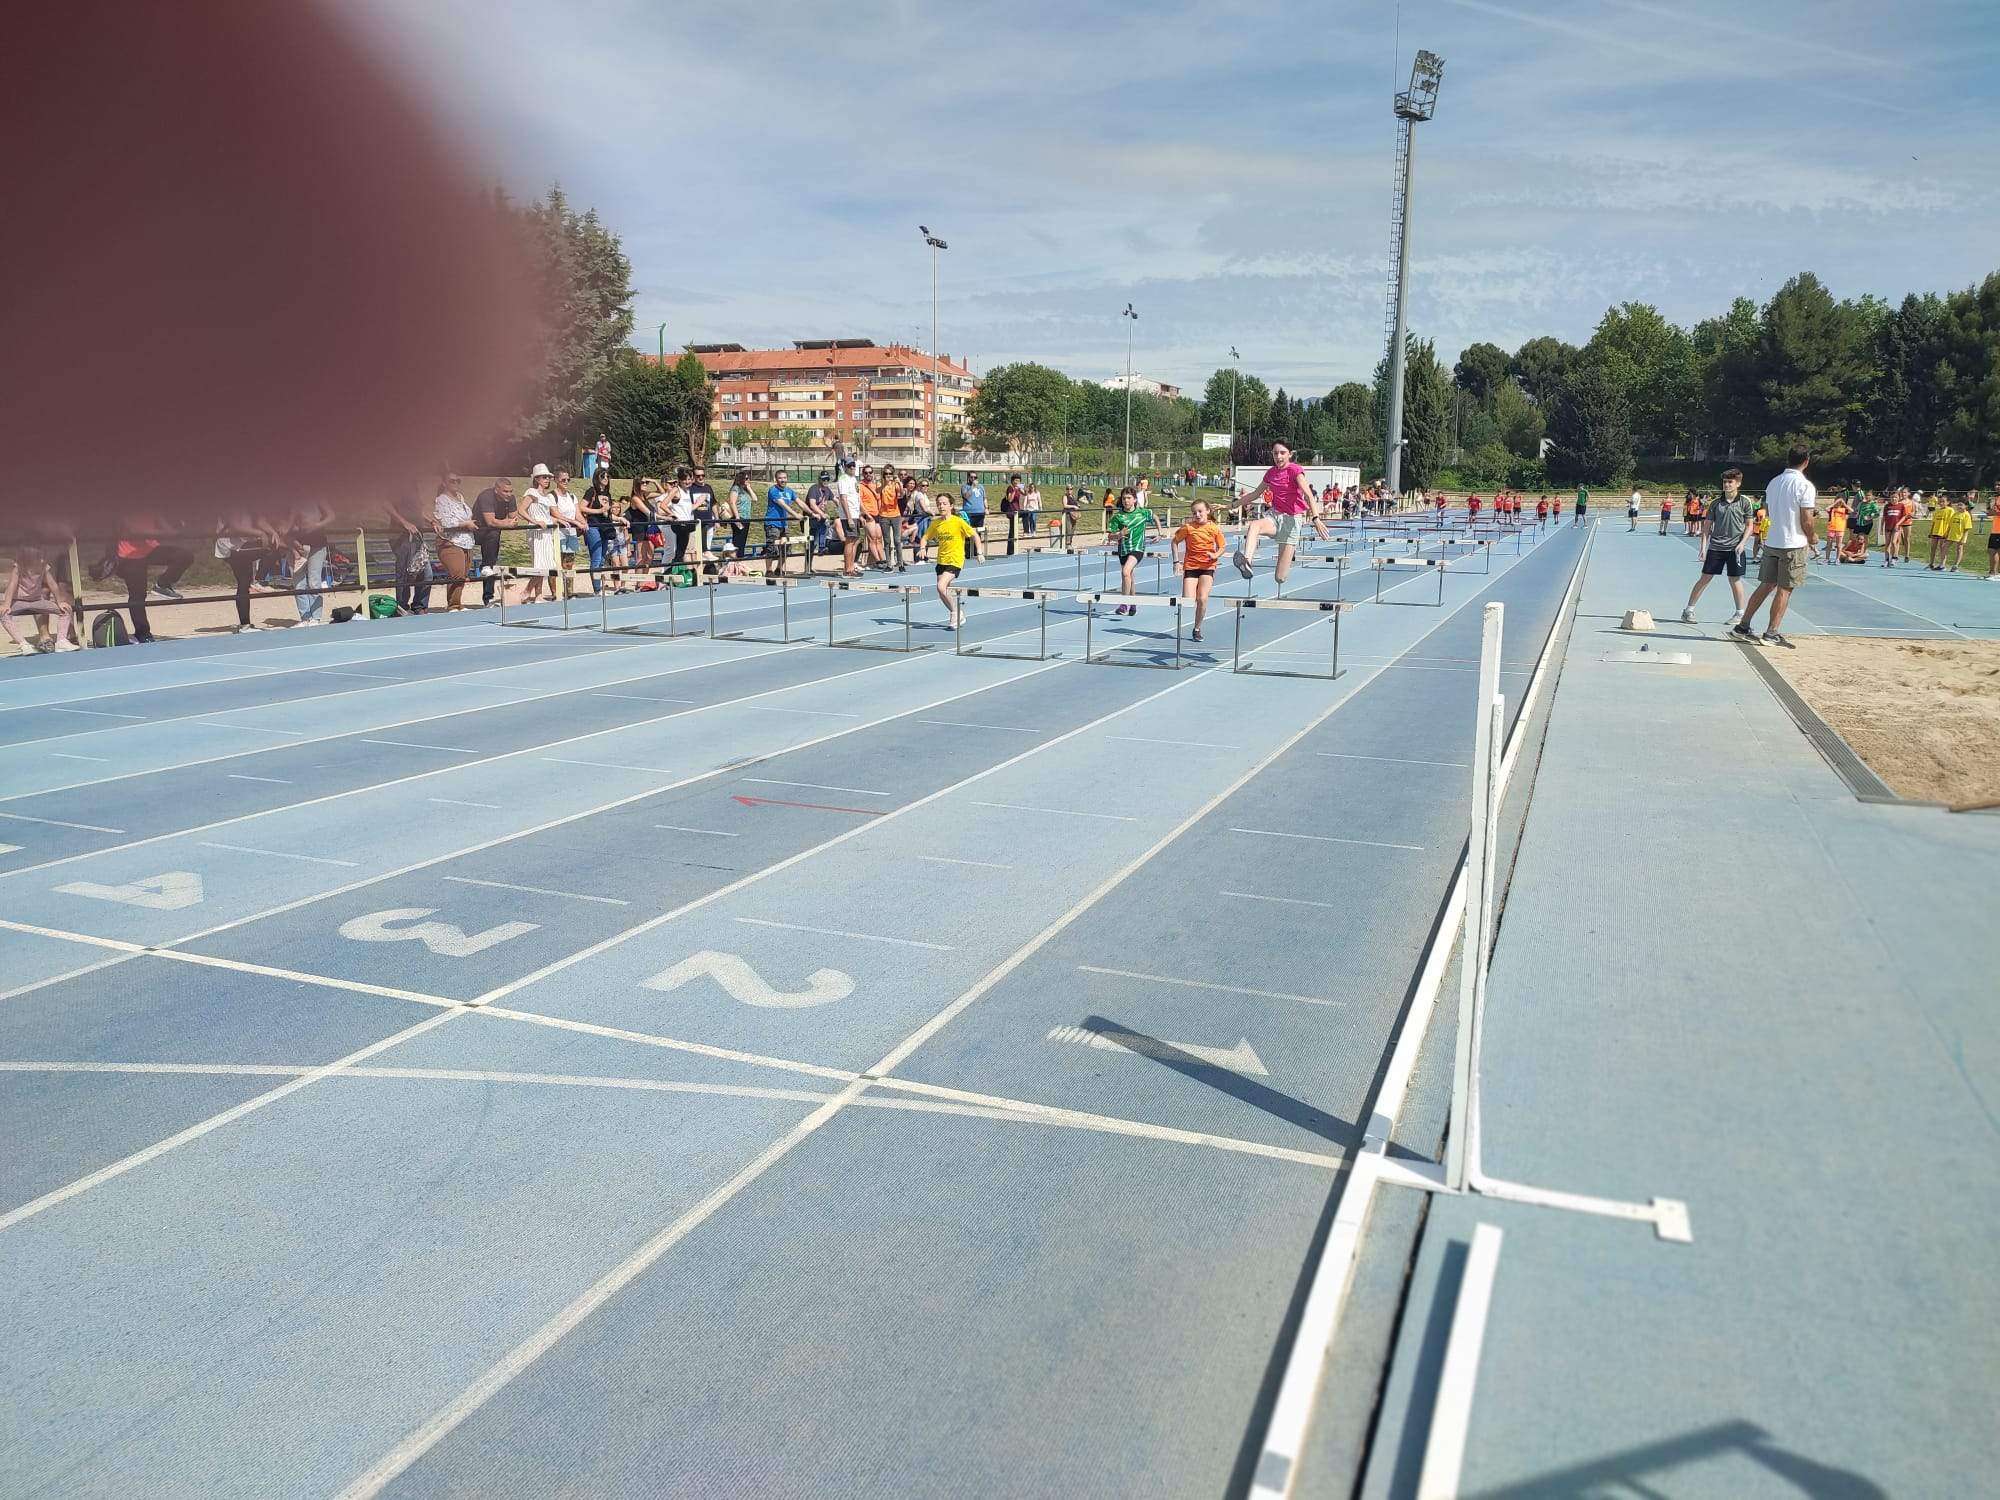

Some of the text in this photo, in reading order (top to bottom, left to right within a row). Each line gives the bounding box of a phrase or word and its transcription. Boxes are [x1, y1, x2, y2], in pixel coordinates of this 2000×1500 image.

[53, 870, 204, 911] 4
[338, 907, 542, 958] 3
[637, 949, 856, 1009] 2
